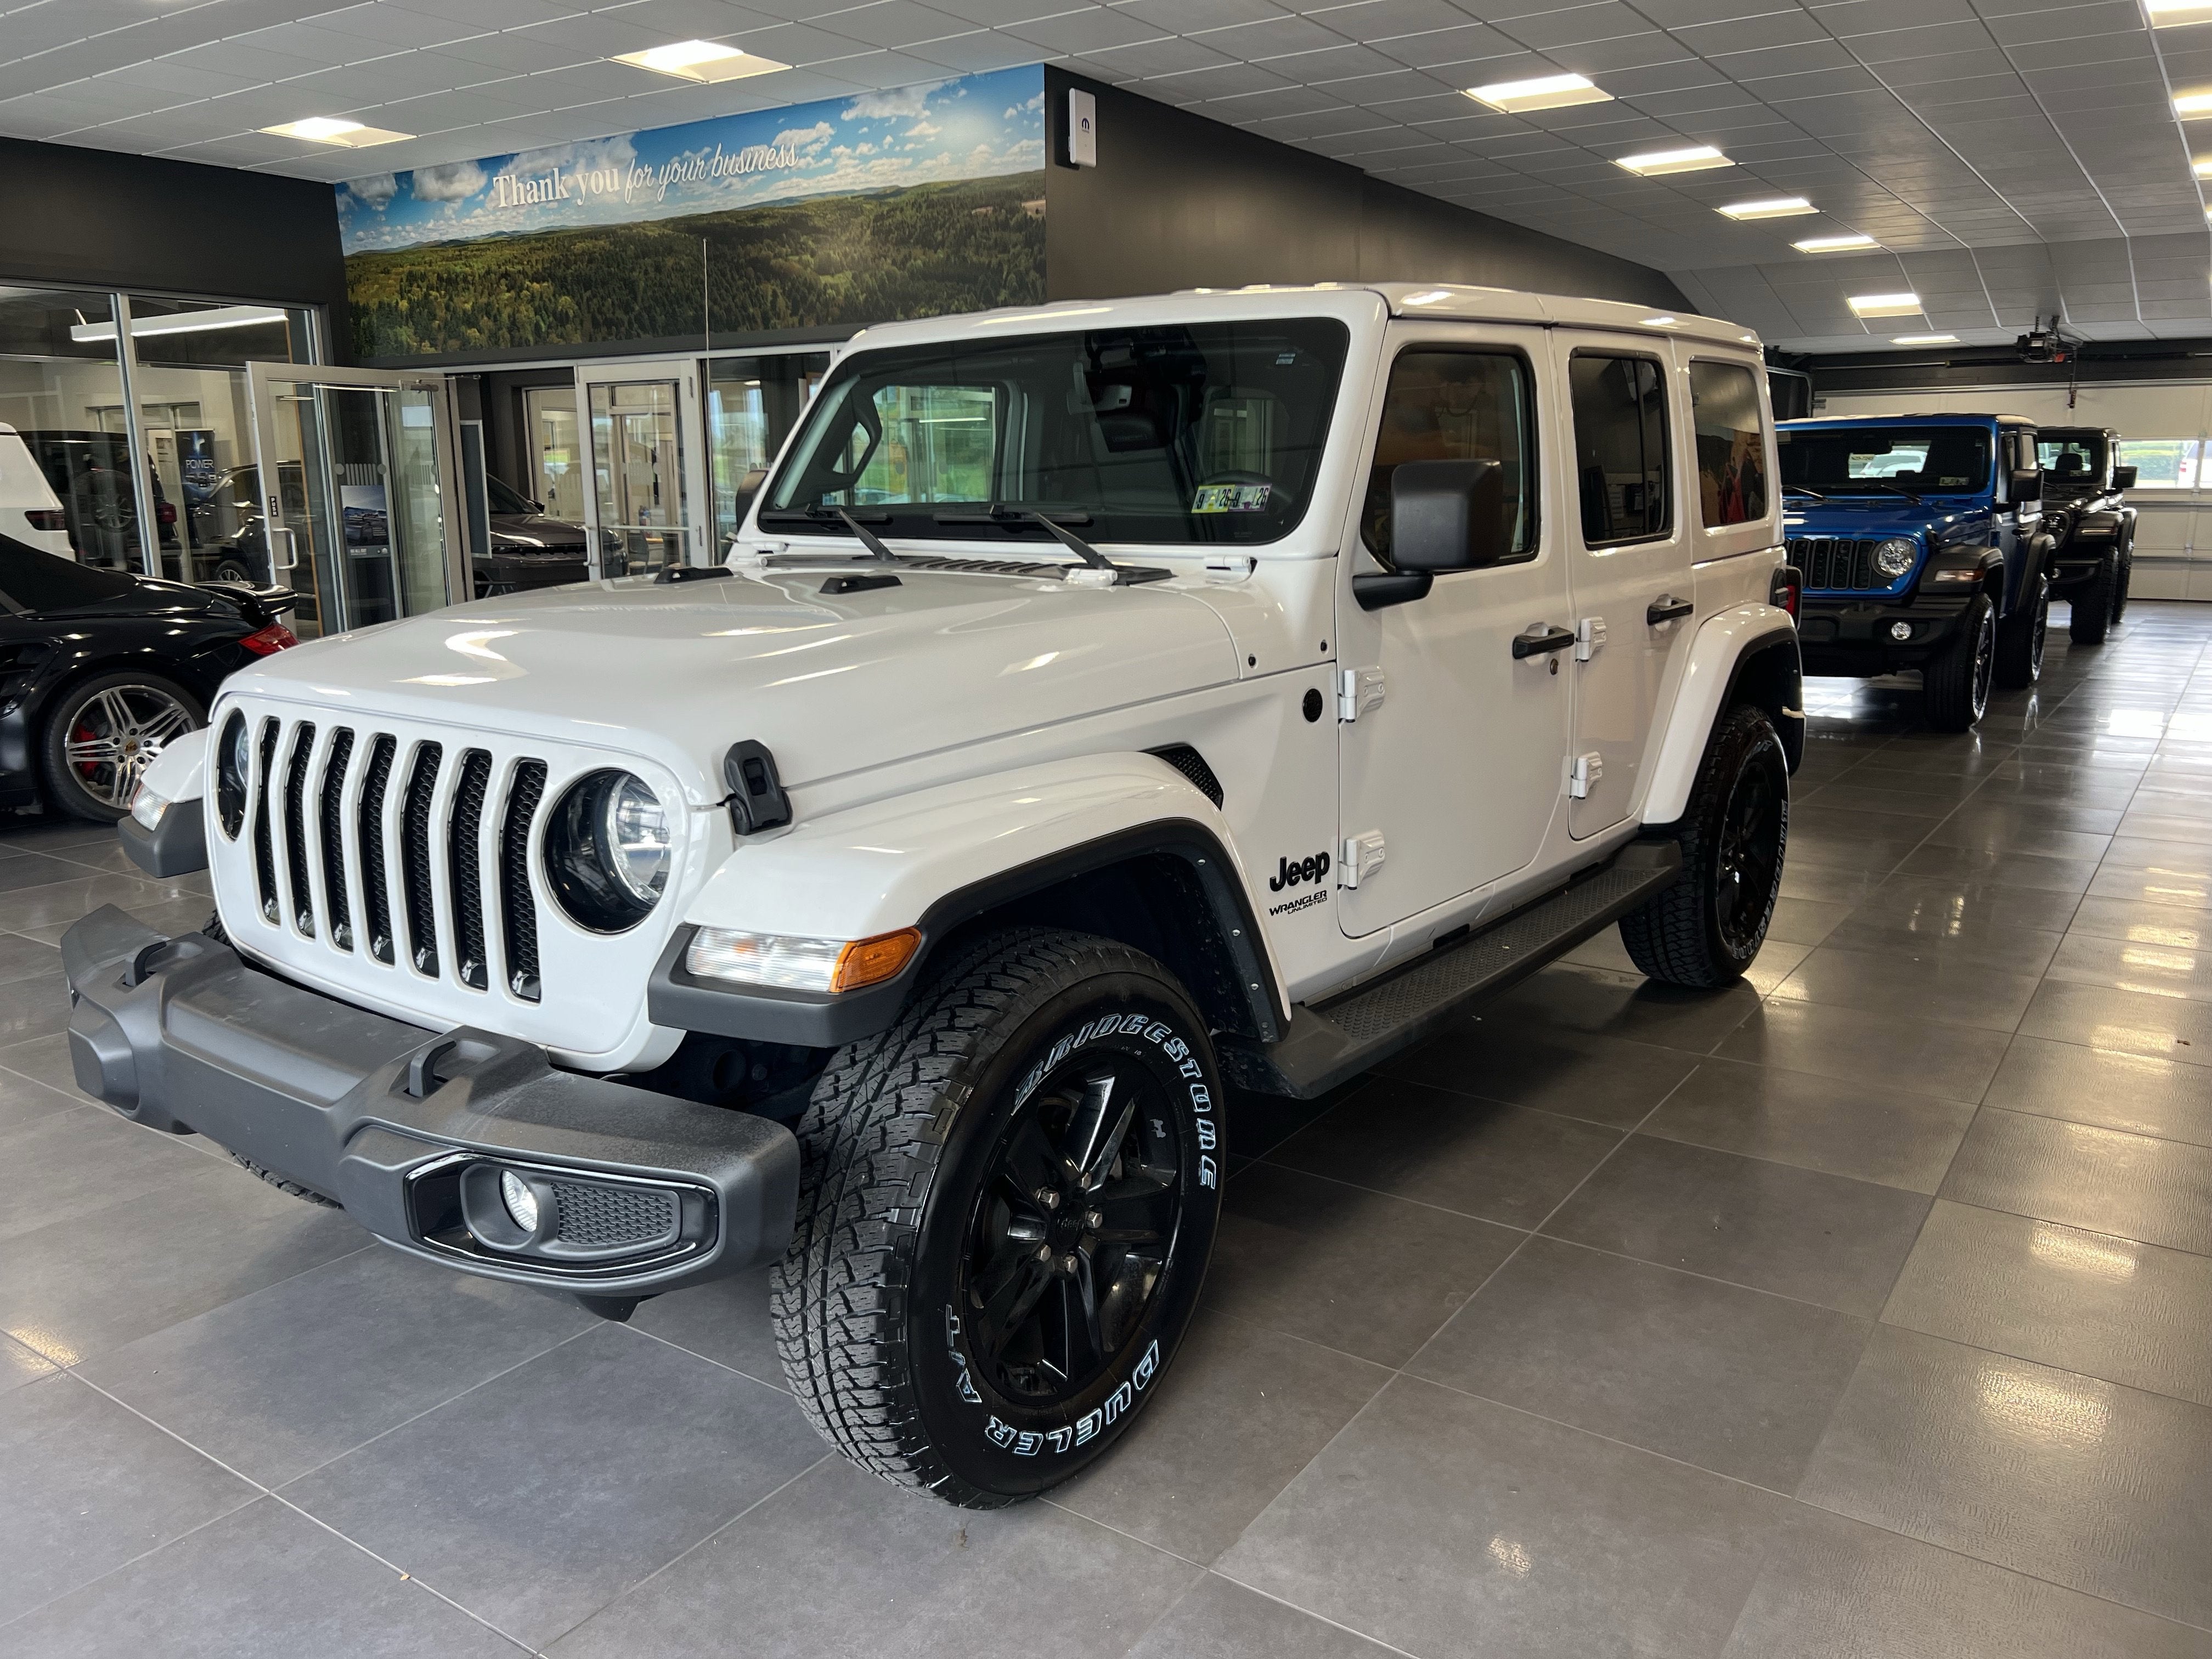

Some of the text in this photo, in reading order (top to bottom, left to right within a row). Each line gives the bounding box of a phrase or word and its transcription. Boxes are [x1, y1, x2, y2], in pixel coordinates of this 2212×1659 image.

[493, 142, 799, 208] Thank you for your business
[185, 459, 215, 469] POWER
[1197, 488, 1232, 509] 9 26
[1233, 491, 1242, 508] 9
[1269, 851, 1330, 892] Jeep
[1268, 889, 1327, 916] WRANGLER
[1287, 897, 1328, 915] UNLIMITED
[1011, 1013, 1217, 1190] BRIDGESTONE
[985, 1339, 1160, 1457] DUELER
